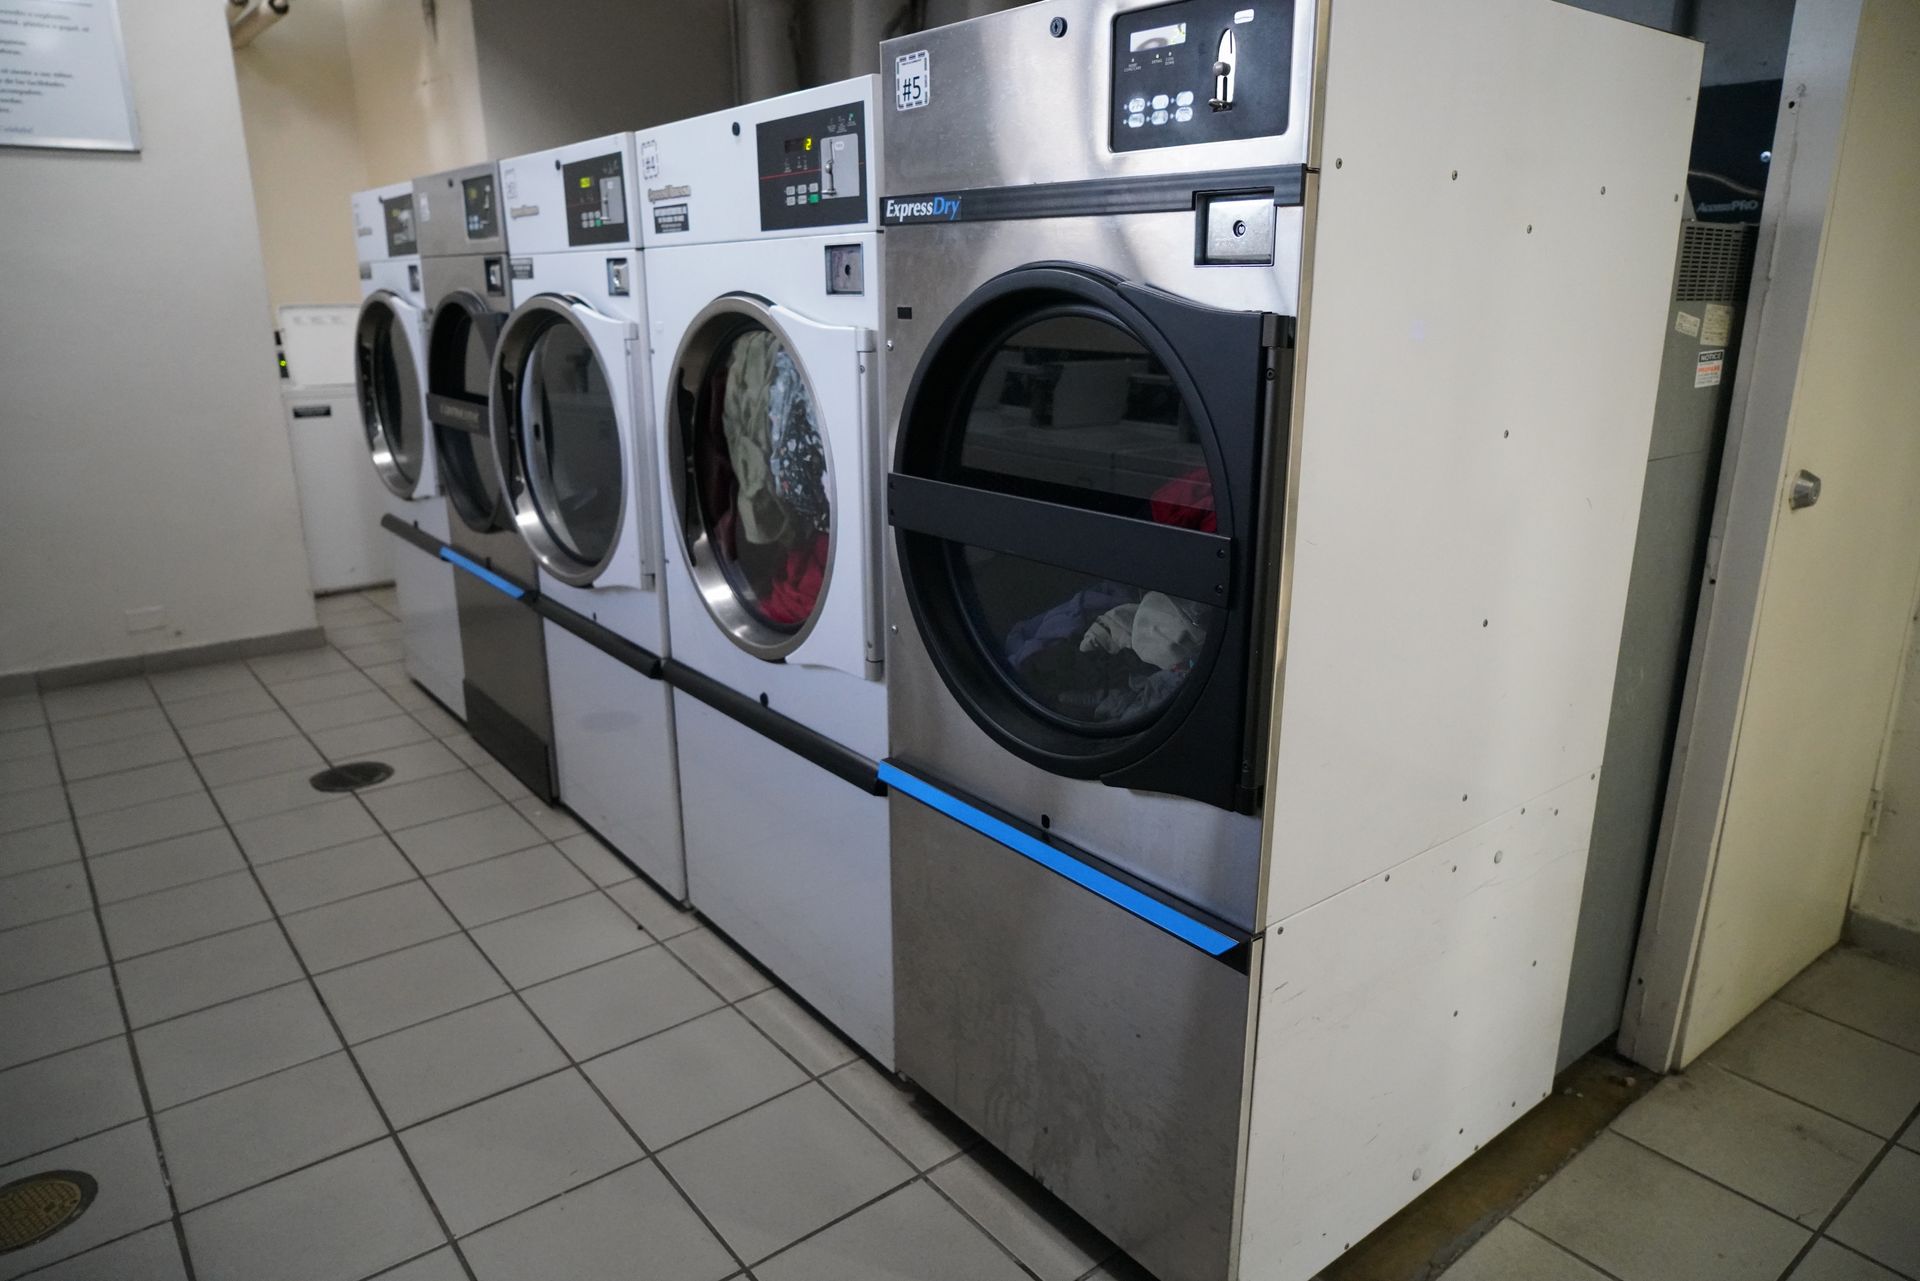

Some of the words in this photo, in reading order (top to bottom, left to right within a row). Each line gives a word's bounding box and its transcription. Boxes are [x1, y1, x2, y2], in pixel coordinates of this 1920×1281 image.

[903, 76, 921, 101] #5
[805, 137, 813, 151] 2
[886, 197, 960, 222] ExpressDry
